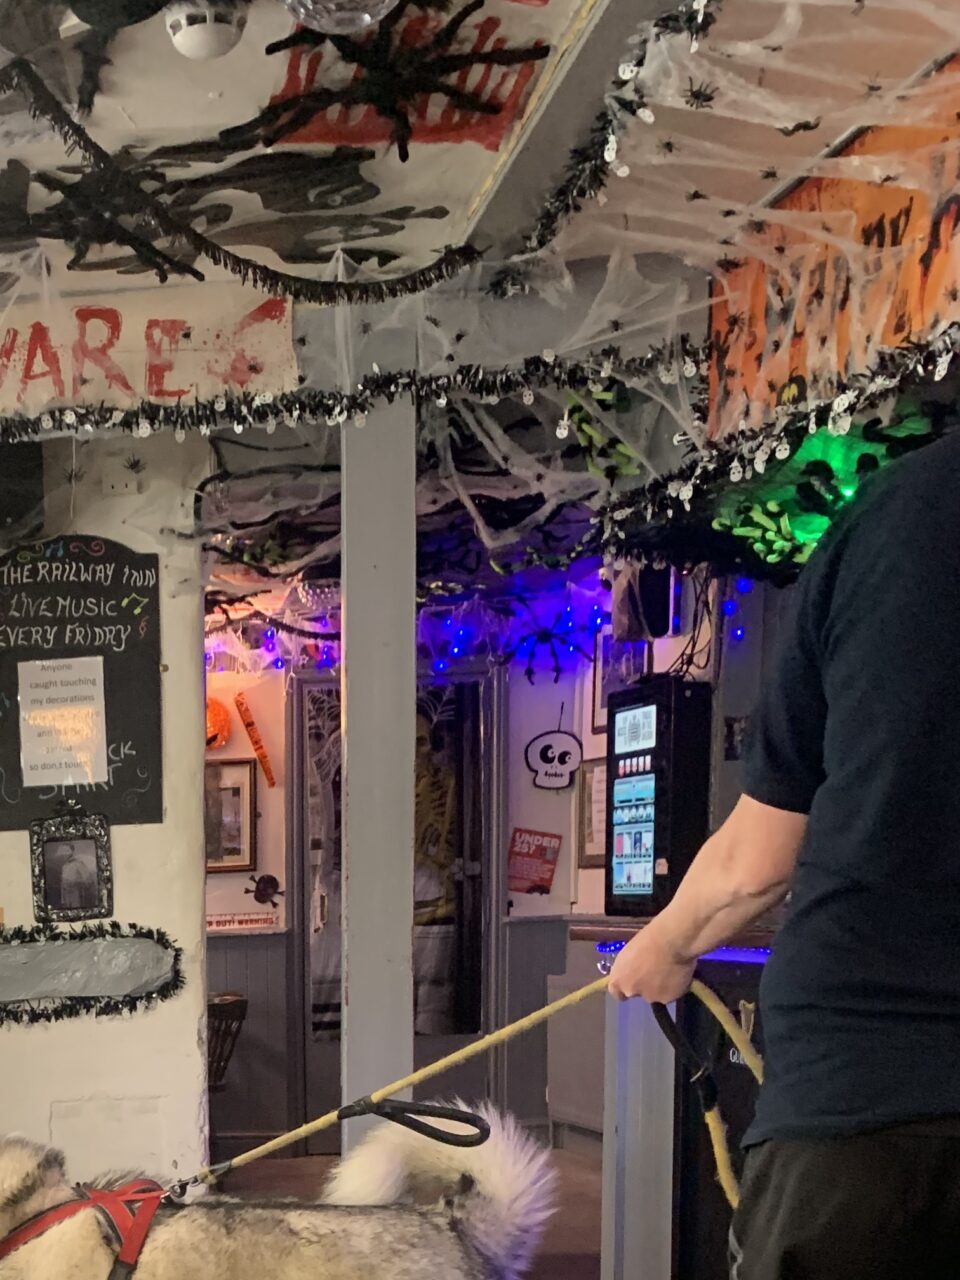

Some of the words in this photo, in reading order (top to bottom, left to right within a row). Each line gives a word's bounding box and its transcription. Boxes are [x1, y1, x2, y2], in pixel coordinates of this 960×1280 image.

[8, 592, 52, 618] LIVE
[56, 596, 118, 618] MUSIC
[41, 664, 73, 673] Anyone
[29, 679, 58, 690] caught
[60, 677, 97, 687] touching
[30, 698, 44, 706] my
[45, 694, 95, 704] decorations
[515, 832, 561, 849] UNDER
